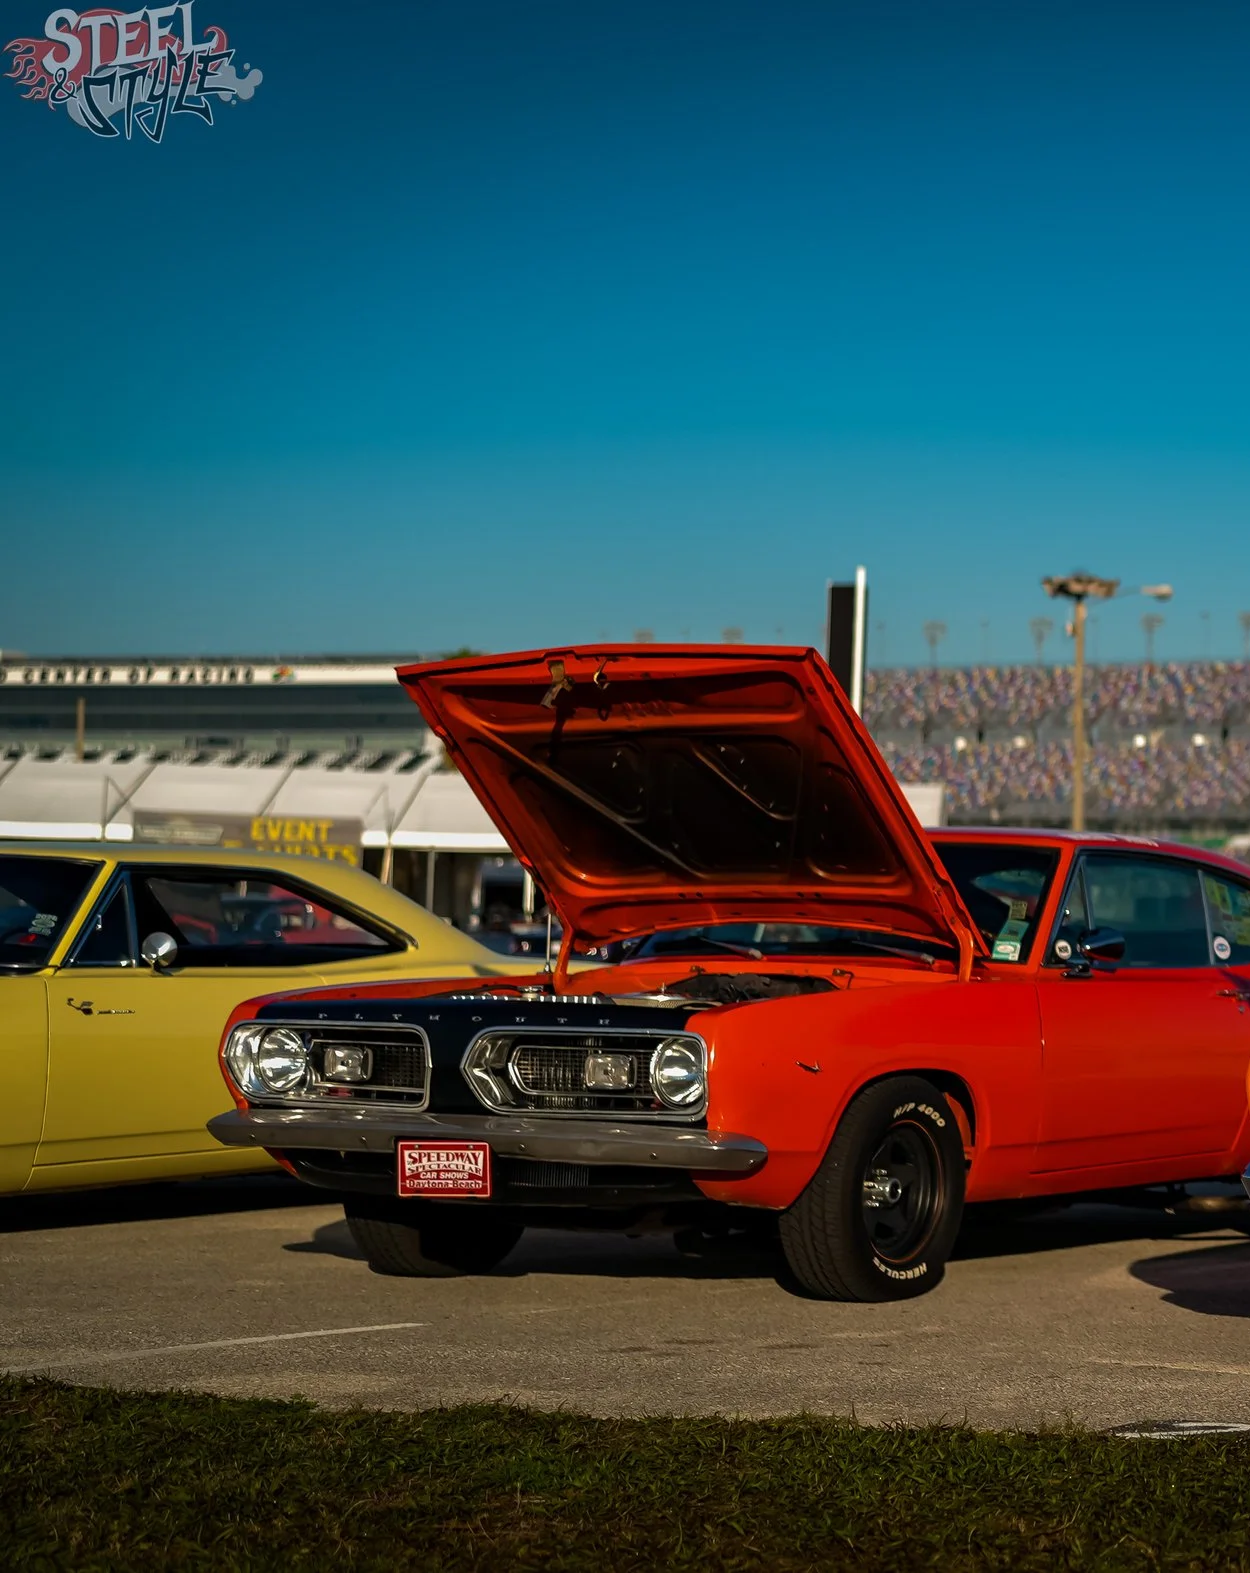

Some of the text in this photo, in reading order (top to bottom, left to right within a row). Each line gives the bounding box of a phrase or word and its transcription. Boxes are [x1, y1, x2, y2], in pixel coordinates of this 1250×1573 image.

[251, 816, 333, 842] EVENT
[917, 1103, 946, 1127] 4000
[408, 1152, 481, 1166] SPEEDWAY
[407, 1163, 482, 1175] SPECTACULAR
